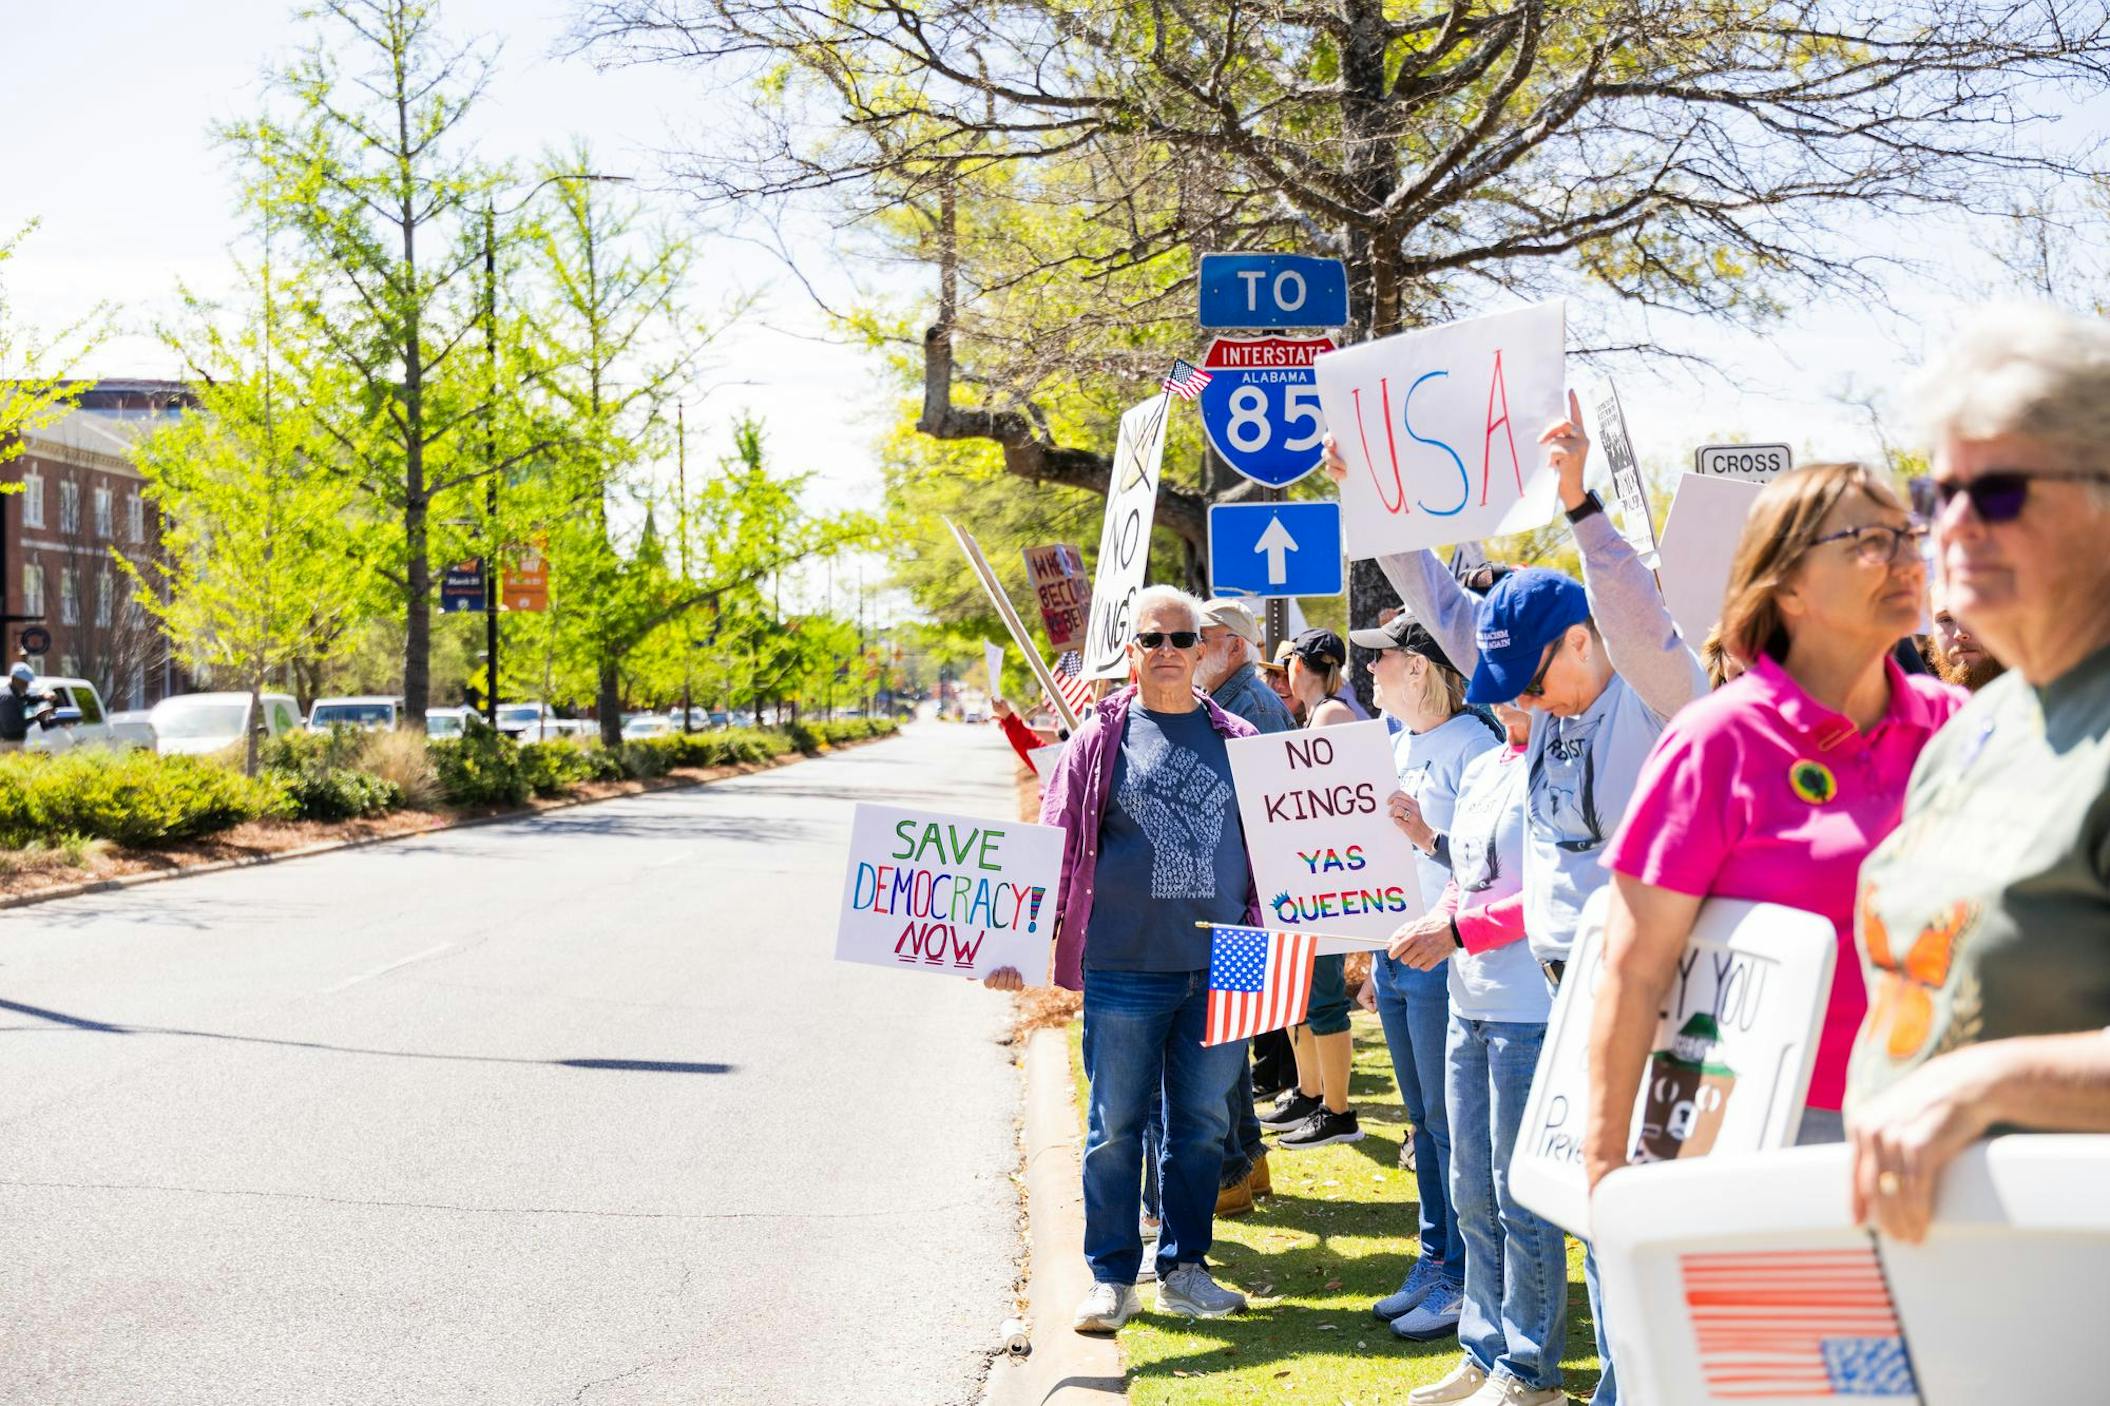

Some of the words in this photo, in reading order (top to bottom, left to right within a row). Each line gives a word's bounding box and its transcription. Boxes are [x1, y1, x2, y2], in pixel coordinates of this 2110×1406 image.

[1237, 270, 1307, 312] TO
[1242, 371, 1307, 383] ALABAMA
[1226, 384, 1328, 453] 85
[1352, 349, 1525, 517] USA
[1713, 453, 1780, 473] CROSS
[1100, 508, 1140, 578] NO
[1088, 586, 1137, 672] KINGS
[1285, 737, 1333, 769] NO
[1264, 783, 1376, 823] KINGS
[892, 820, 1005, 871] SAVE
[1297, 845, 1366, 874] YAS
[853, 862, 1046, 933] DEMOCRACY!
[1275, 886, 1407, 925] QUEENS
[895, 921, 985, 964] NOW
[1714, 951, 1767, 1032] YOU
